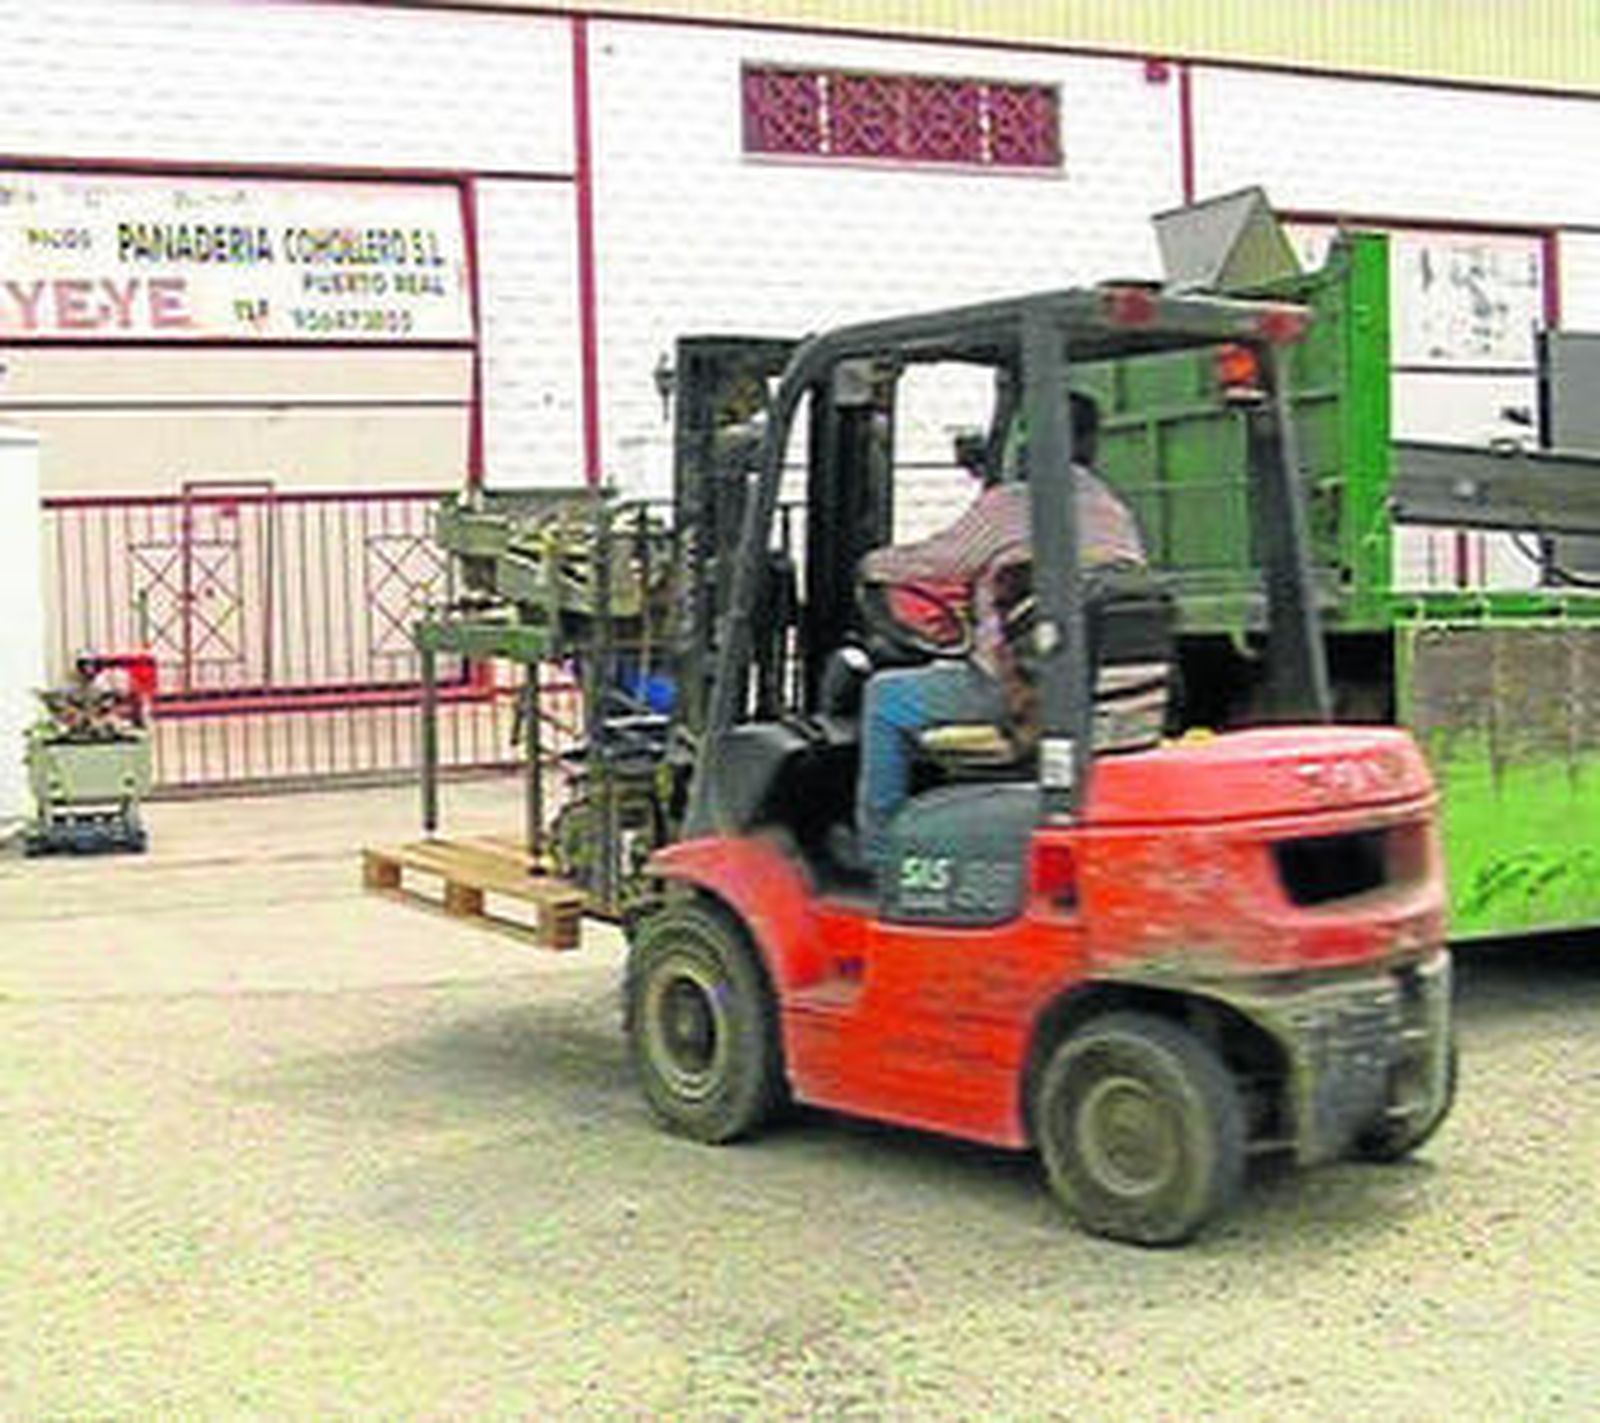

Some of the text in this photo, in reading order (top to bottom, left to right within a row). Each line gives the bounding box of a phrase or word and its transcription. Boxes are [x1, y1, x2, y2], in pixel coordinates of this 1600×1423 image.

[118, 222, 273, 268] PANADERIA
[303, 271, 446, 296] PUERTO REAL
